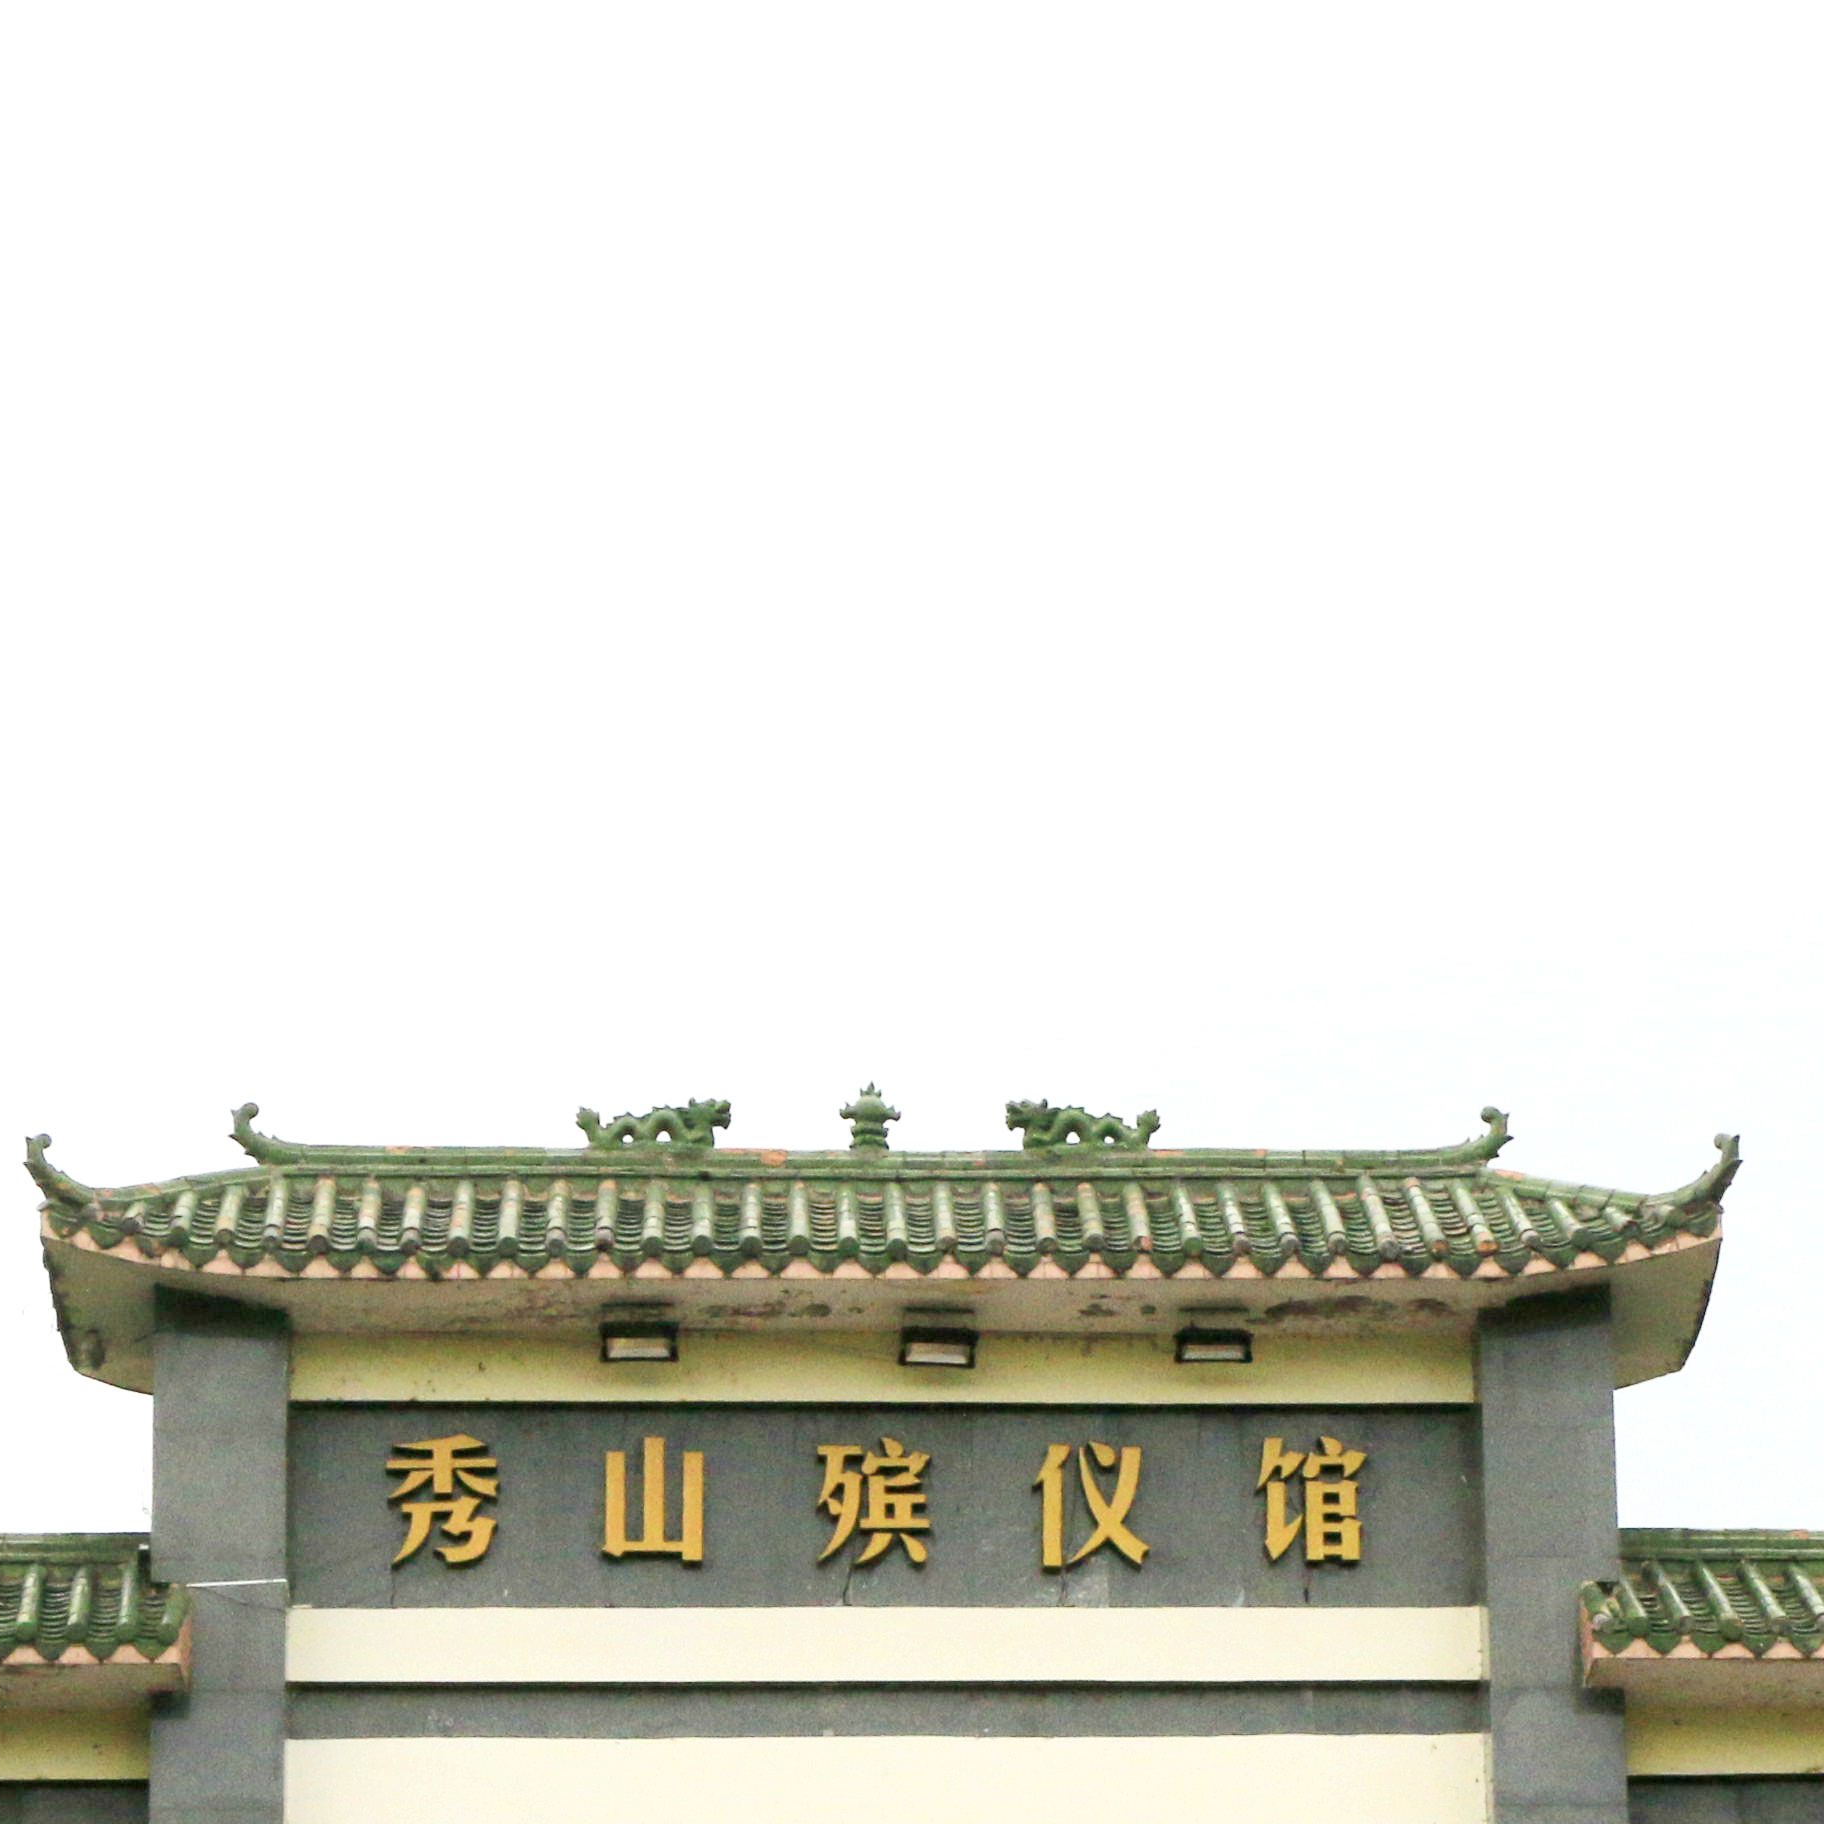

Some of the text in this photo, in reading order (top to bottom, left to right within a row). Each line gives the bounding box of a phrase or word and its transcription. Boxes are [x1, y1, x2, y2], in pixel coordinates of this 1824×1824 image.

[385, 1434, 1366, 1567] 秀山殡仪馆
